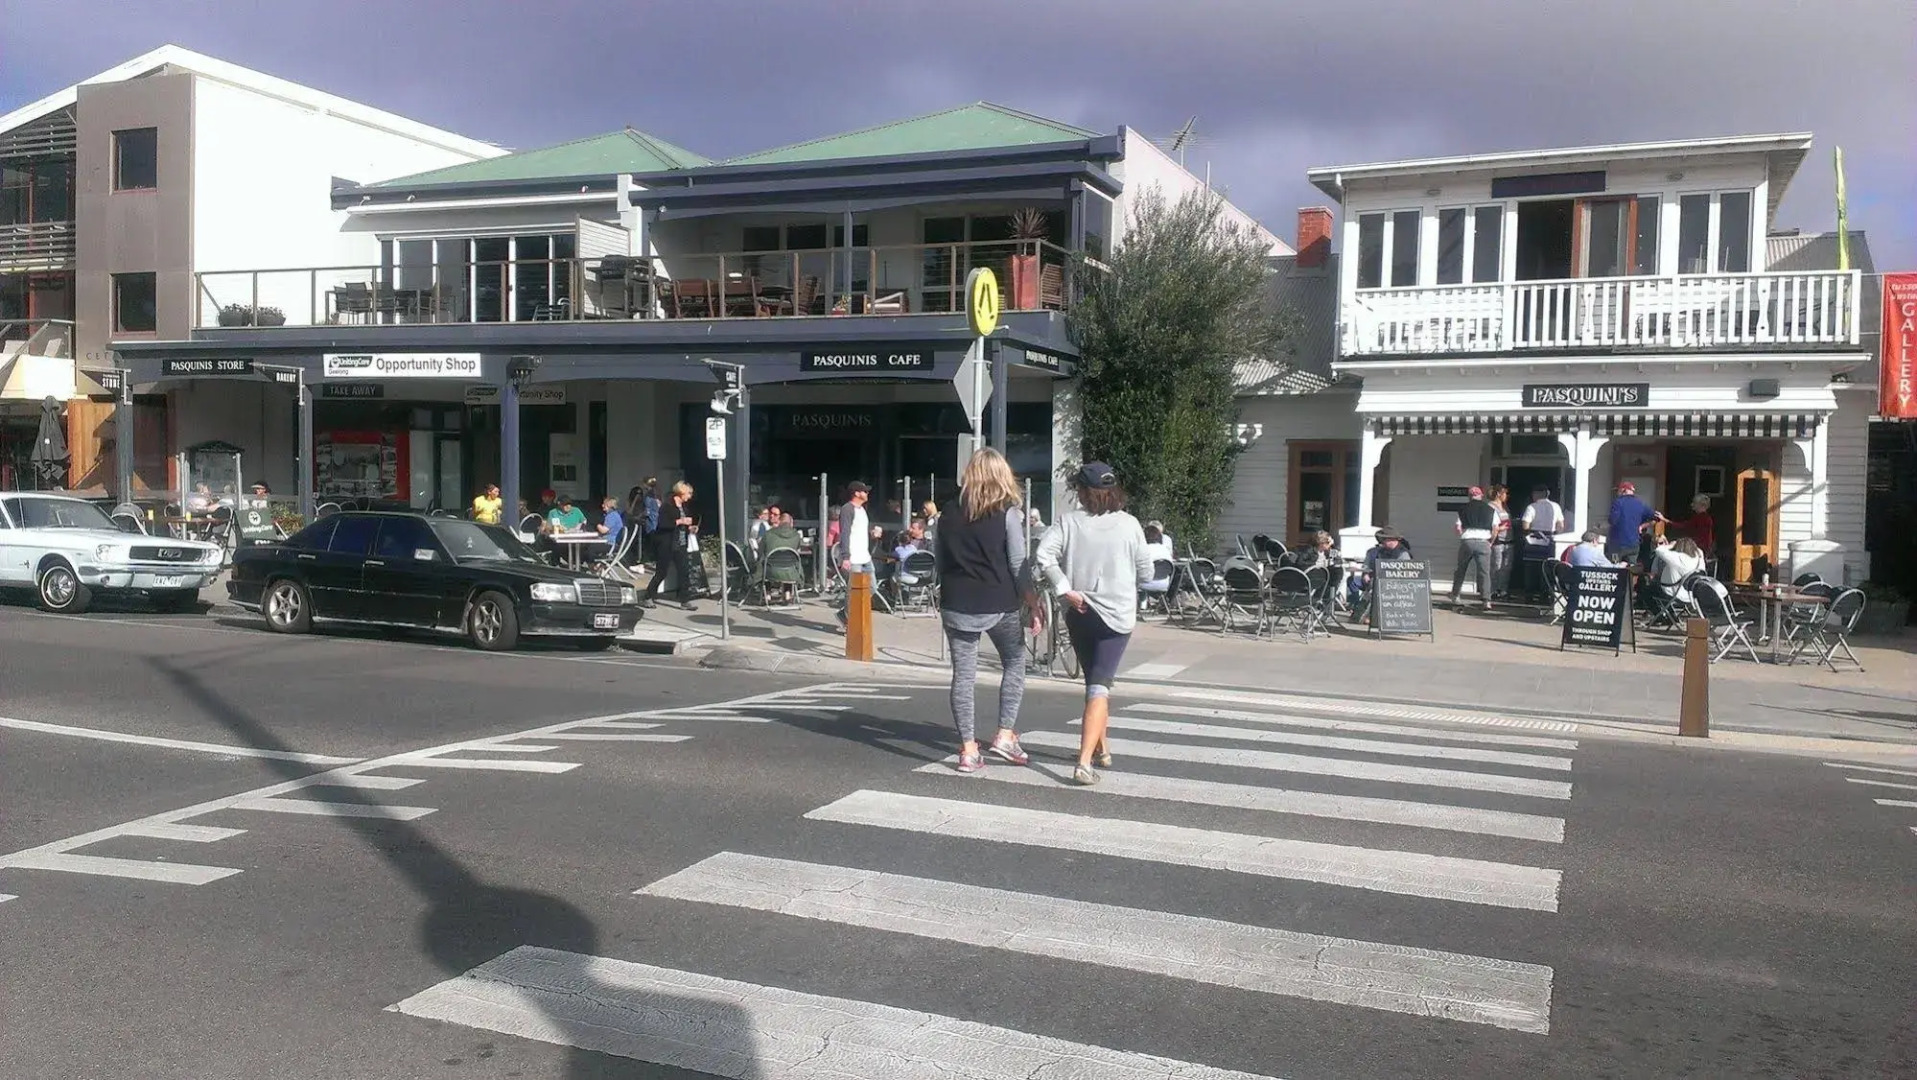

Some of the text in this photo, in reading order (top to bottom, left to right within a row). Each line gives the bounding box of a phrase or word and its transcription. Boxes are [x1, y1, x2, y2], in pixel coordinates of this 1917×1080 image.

[813, 355, 921, 367] PASQUINIS CAFE
[1900, 302, 1916, 408] GALLERY
[171, 359, 245, 372] PASQUINIS STORE
[376, 357, 442, 374] Opportunity
[445, 357, 476, 373] Shop
[102, 377, 120, 389] STORE
[275, 371, 296, 383] BAKERY
[330, 385, 376, 395] TAKE AWAY
[544, 390, 564, 401] Shop
[1533, 386, 1638, 406] PASQUINI'S
[792, 414, 871, 428] PASQUINIS
[1381, 561, 1425, 570] PASQUINIS
[1385, 570, 1420, 578] BAKERY
[1580, 570, 1619, 580] TUSSOCK
[1578, 583, 1617, 592] GALLERY
[1578, 595, 1616, 610] NOW
[1573, 609, 1616, 625] OPEN
[1572, 627, 1597, 635] THROUGH
